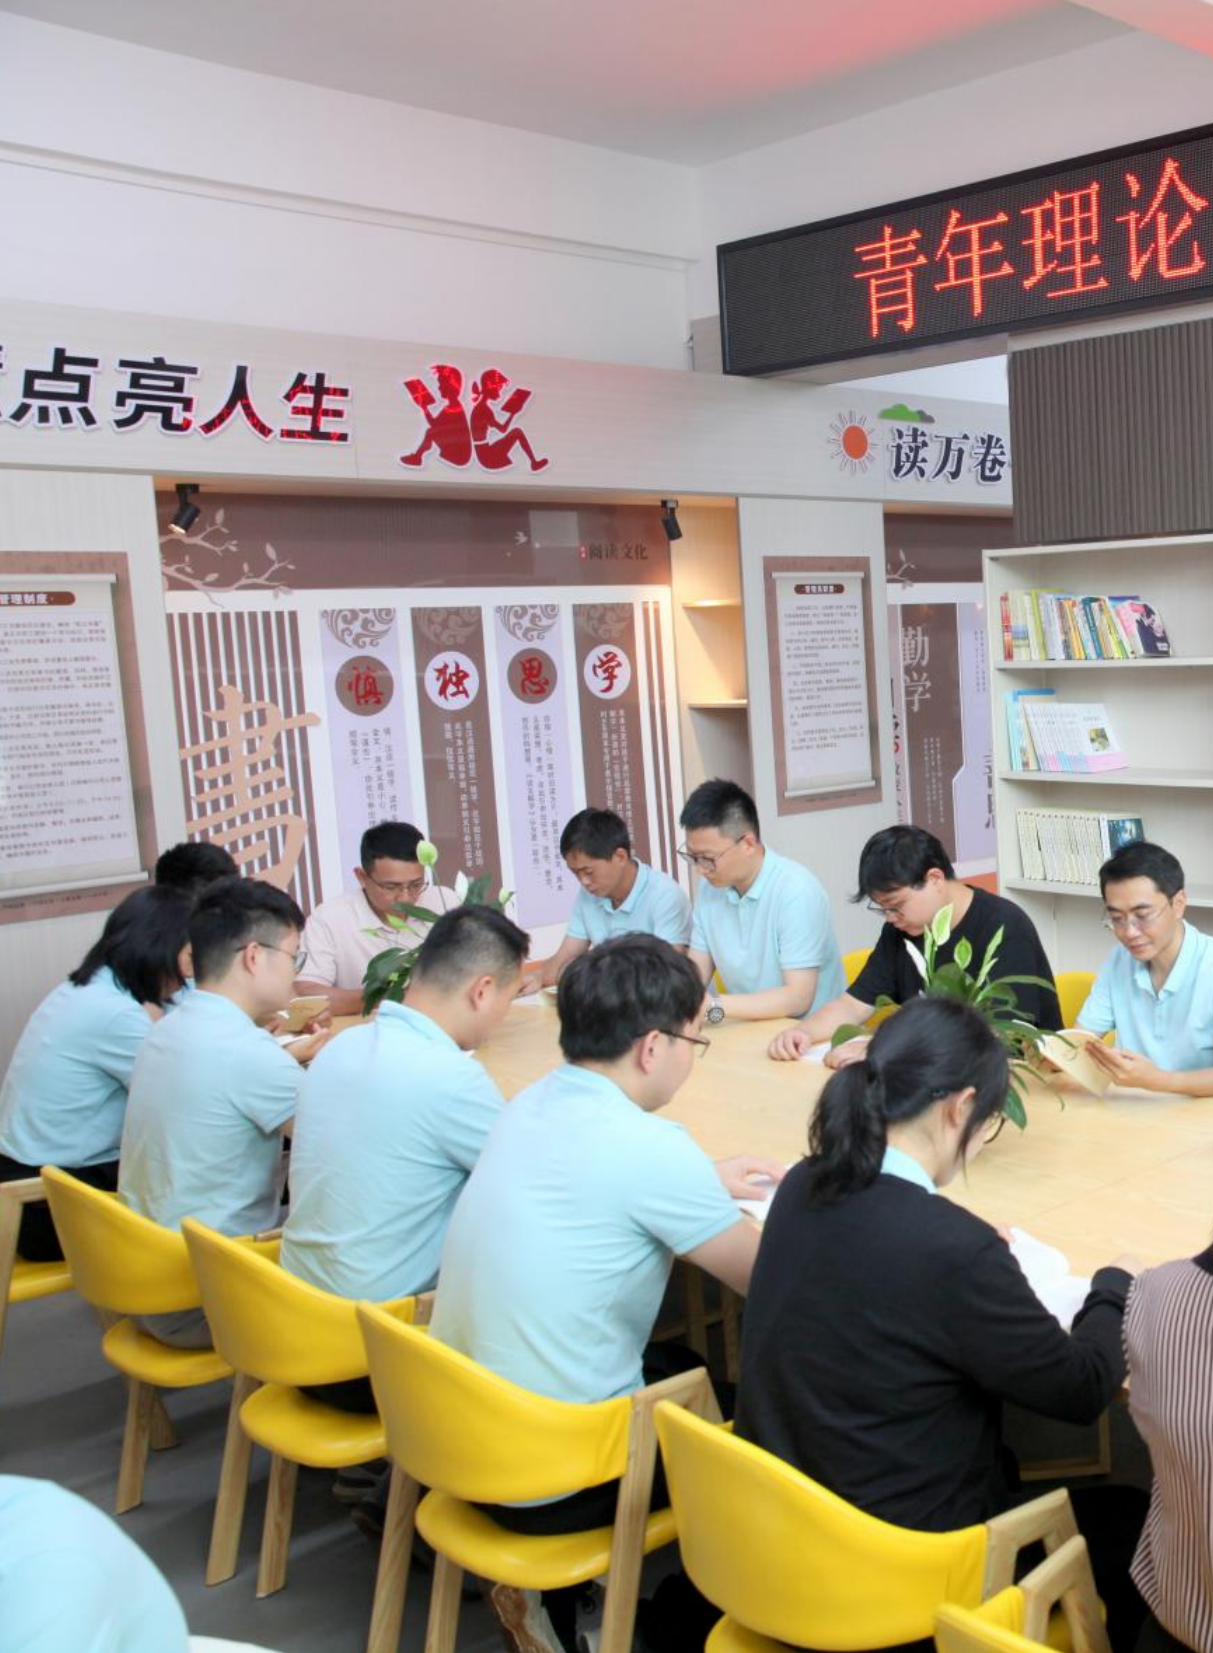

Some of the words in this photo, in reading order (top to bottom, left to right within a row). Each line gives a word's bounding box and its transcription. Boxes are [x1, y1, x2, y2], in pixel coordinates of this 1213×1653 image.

[0, 347, 349, 442] 点亮人生
[891, 426, 1007, 482] 读万卷
[346, 664, 383, 706] 慎
[434, 660, 471, 701] 独
[519, 654, 549, 693] 思
[592, 652, 623, 692] 学
[902, 625, 932, 713] 勤学
